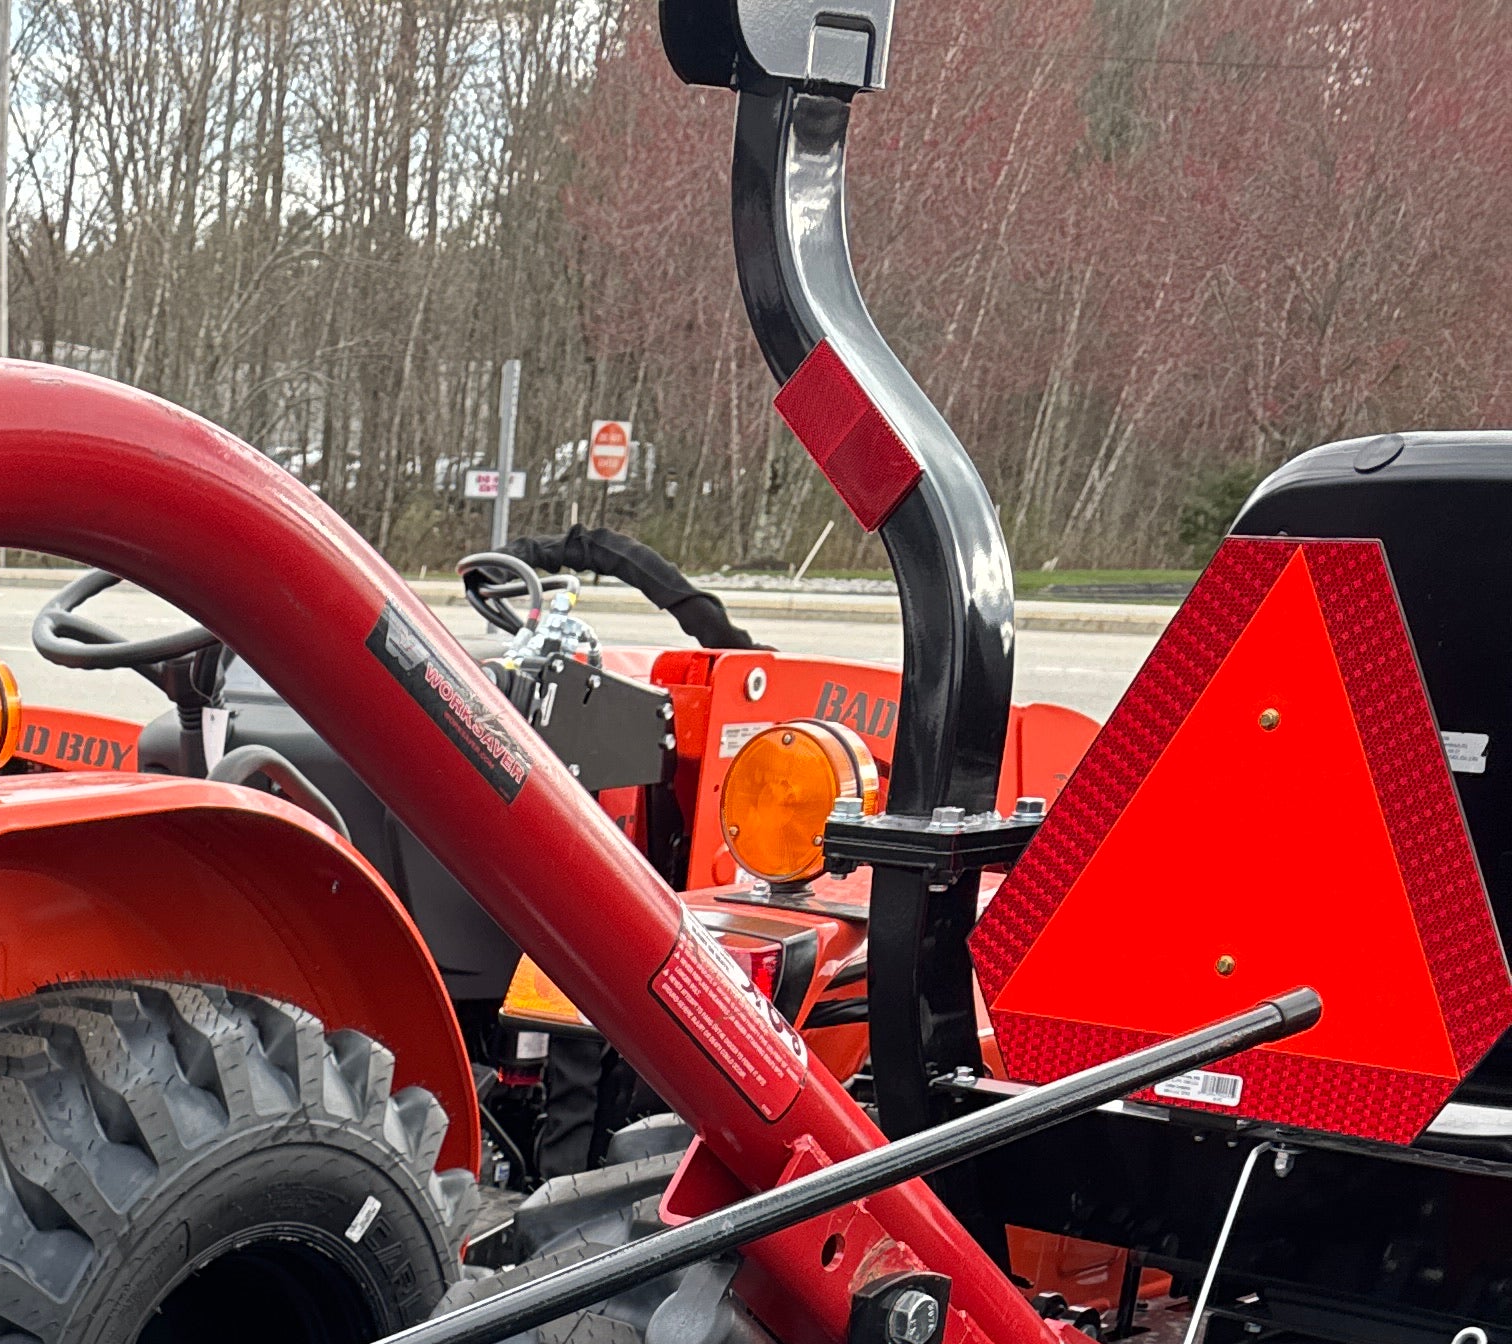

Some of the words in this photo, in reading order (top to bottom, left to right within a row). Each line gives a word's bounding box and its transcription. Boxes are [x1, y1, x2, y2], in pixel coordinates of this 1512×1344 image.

[424, 661, 525, 785] WORKSAVER
[814, 681, 897, 738] BAD
[56, 731, 134, 770] BOY
